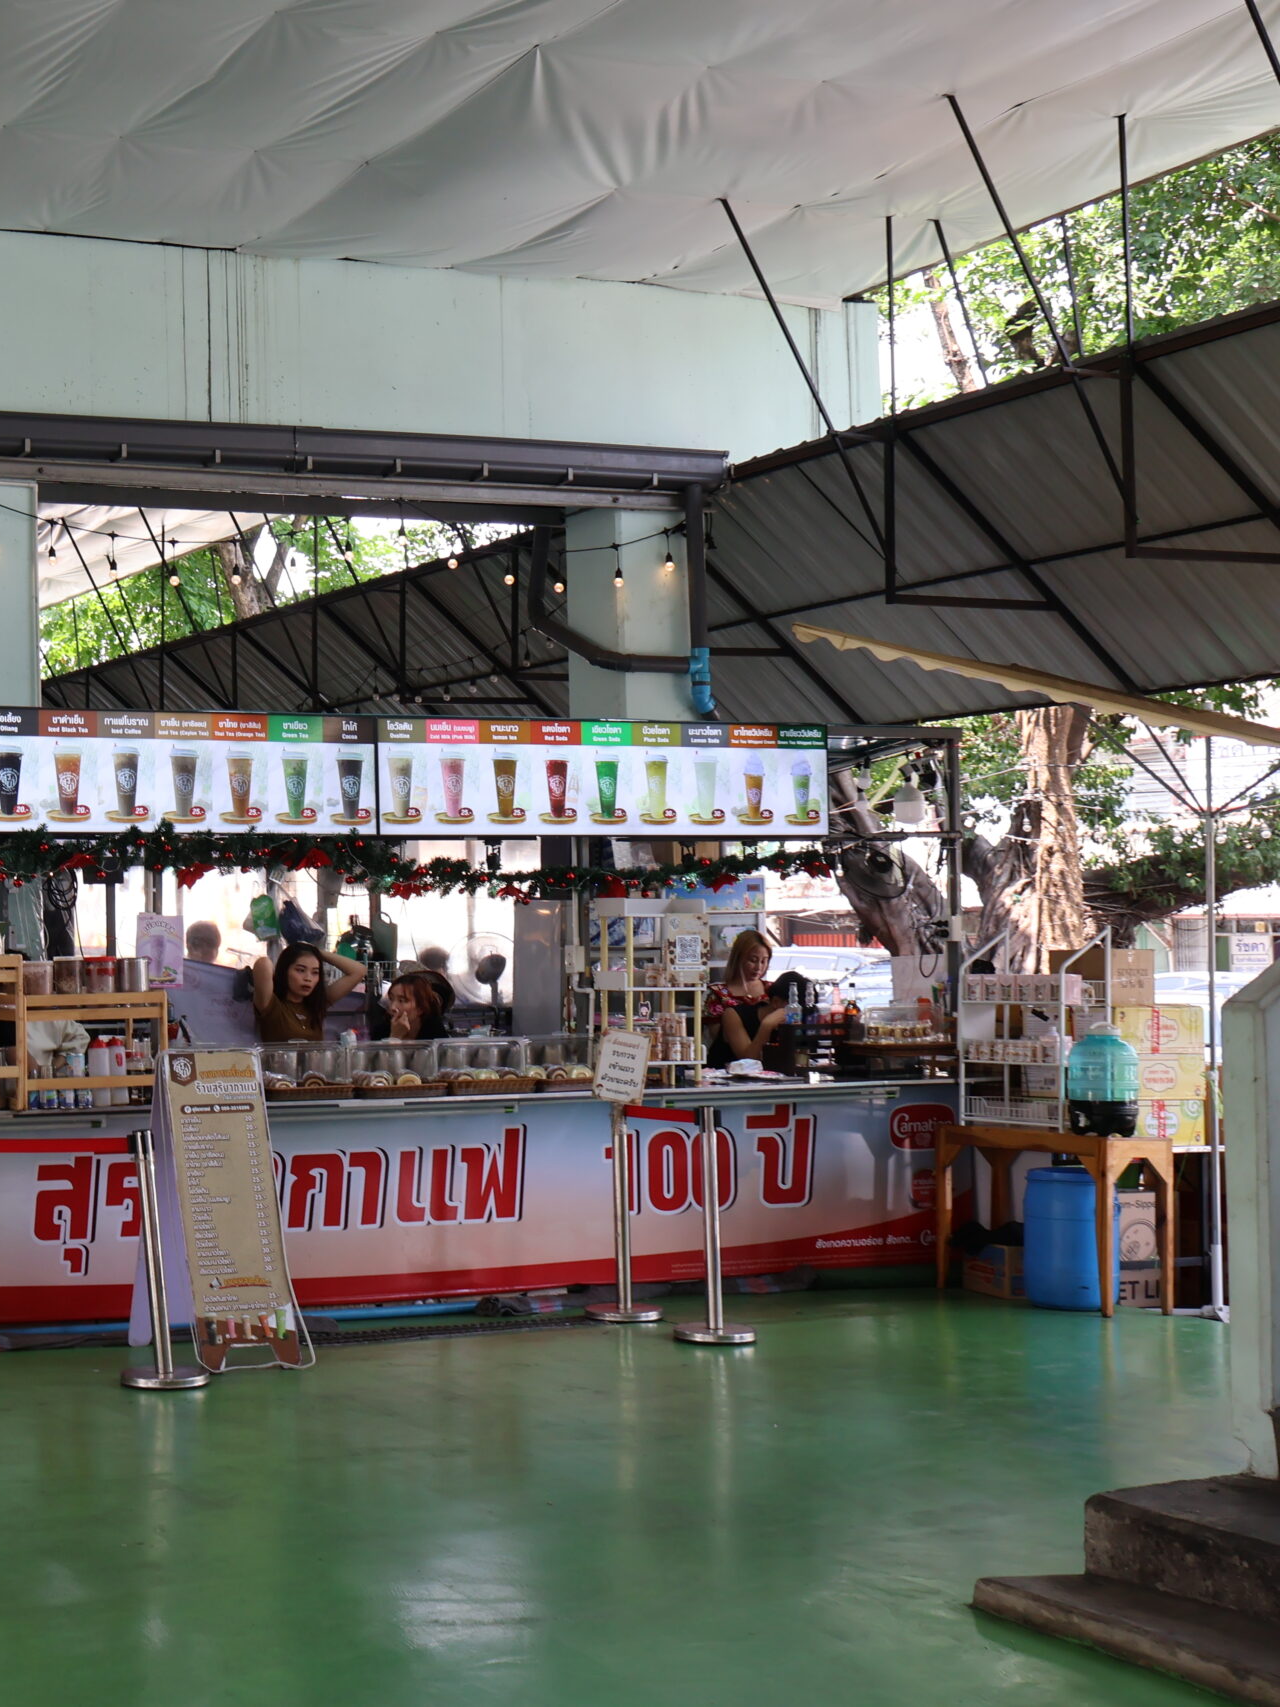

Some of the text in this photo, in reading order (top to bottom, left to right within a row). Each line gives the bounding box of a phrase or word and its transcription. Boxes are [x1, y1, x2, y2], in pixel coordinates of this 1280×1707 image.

[52, 714, 84, 725] ชาดำเย็น
[104, 715, 149, 727] กาแฟโบราณ
[218, 718, 238, 728] ชาไทย
[0, 725, 19, 734] Oliang
[282, 720, 308, 730] ชาเขียว
[342, 720, 358, 732] โกโก้
[387, 720, 413, 731] โอวัลติน
[430, 722, 451, 732] นมเย็น
[490, 723, 519, 733] ชามะนาว
[541, 723, 570, 733] แดงโซดา
[591, 724, 622, 734] เขียวโซดา
[688, 725, 721, 736] มะนาวโซดา
[745, 1103, 812, 1206] ปี
